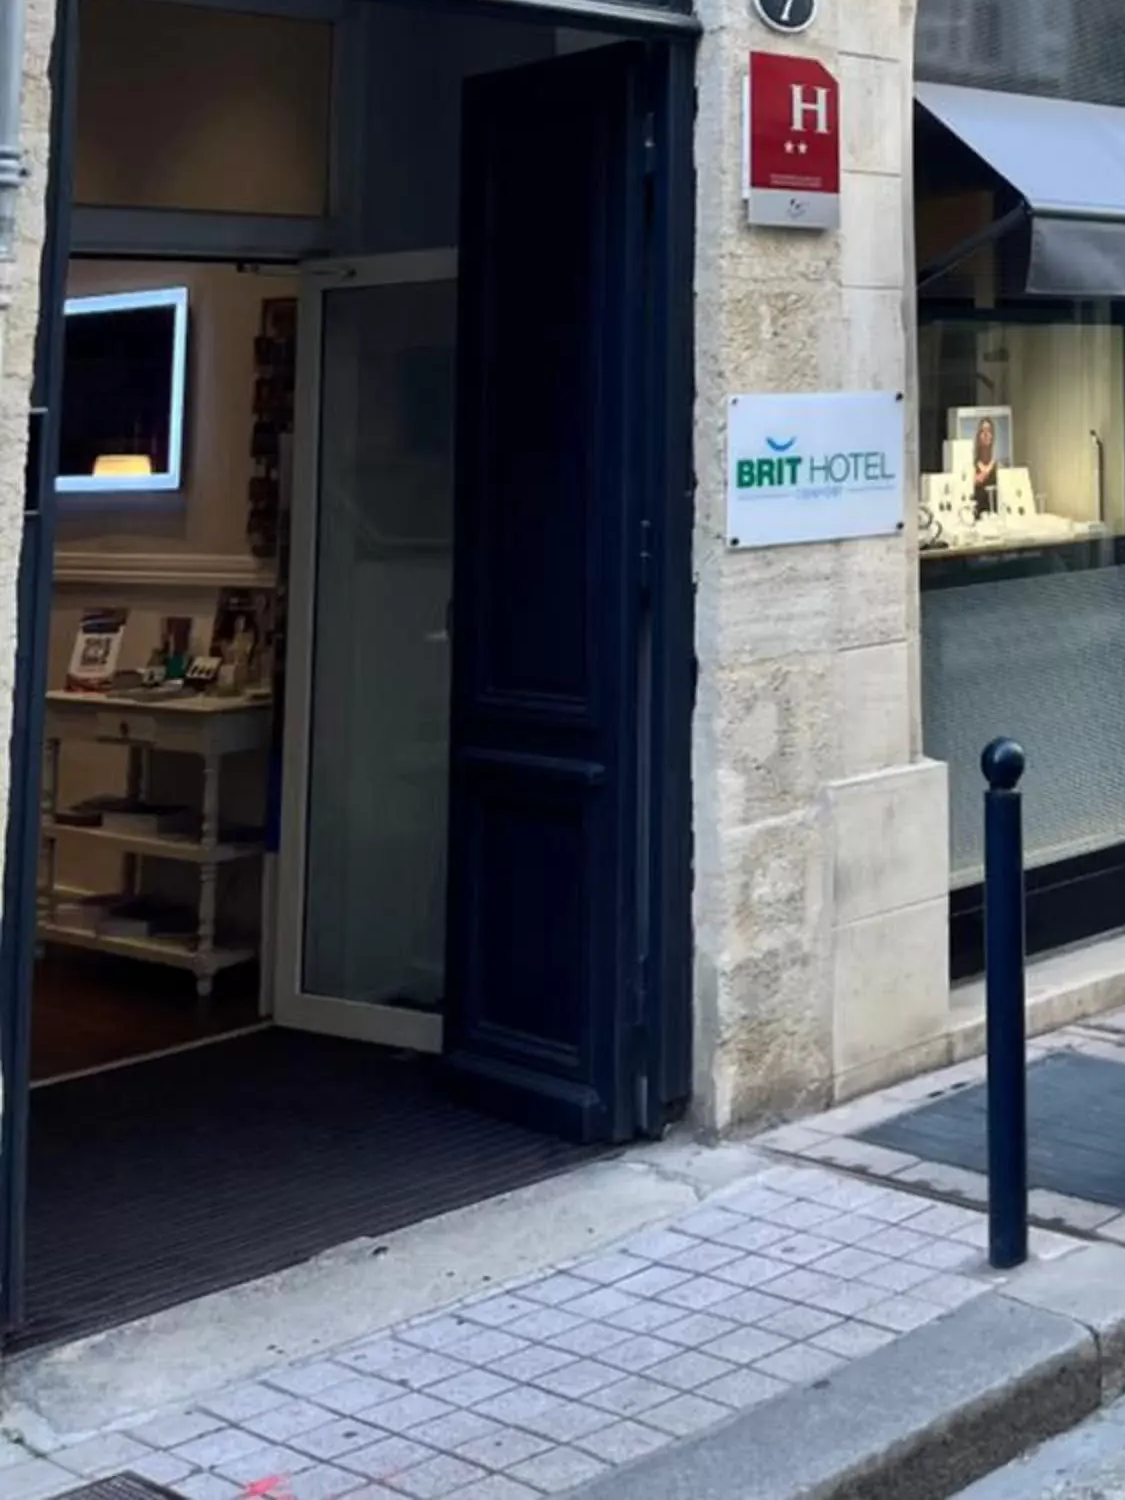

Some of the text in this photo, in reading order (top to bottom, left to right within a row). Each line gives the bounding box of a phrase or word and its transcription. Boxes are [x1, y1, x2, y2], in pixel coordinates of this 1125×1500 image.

[788, 83, 831, 135] H
[736, 452, 895, 488] BRIT HOTEL
